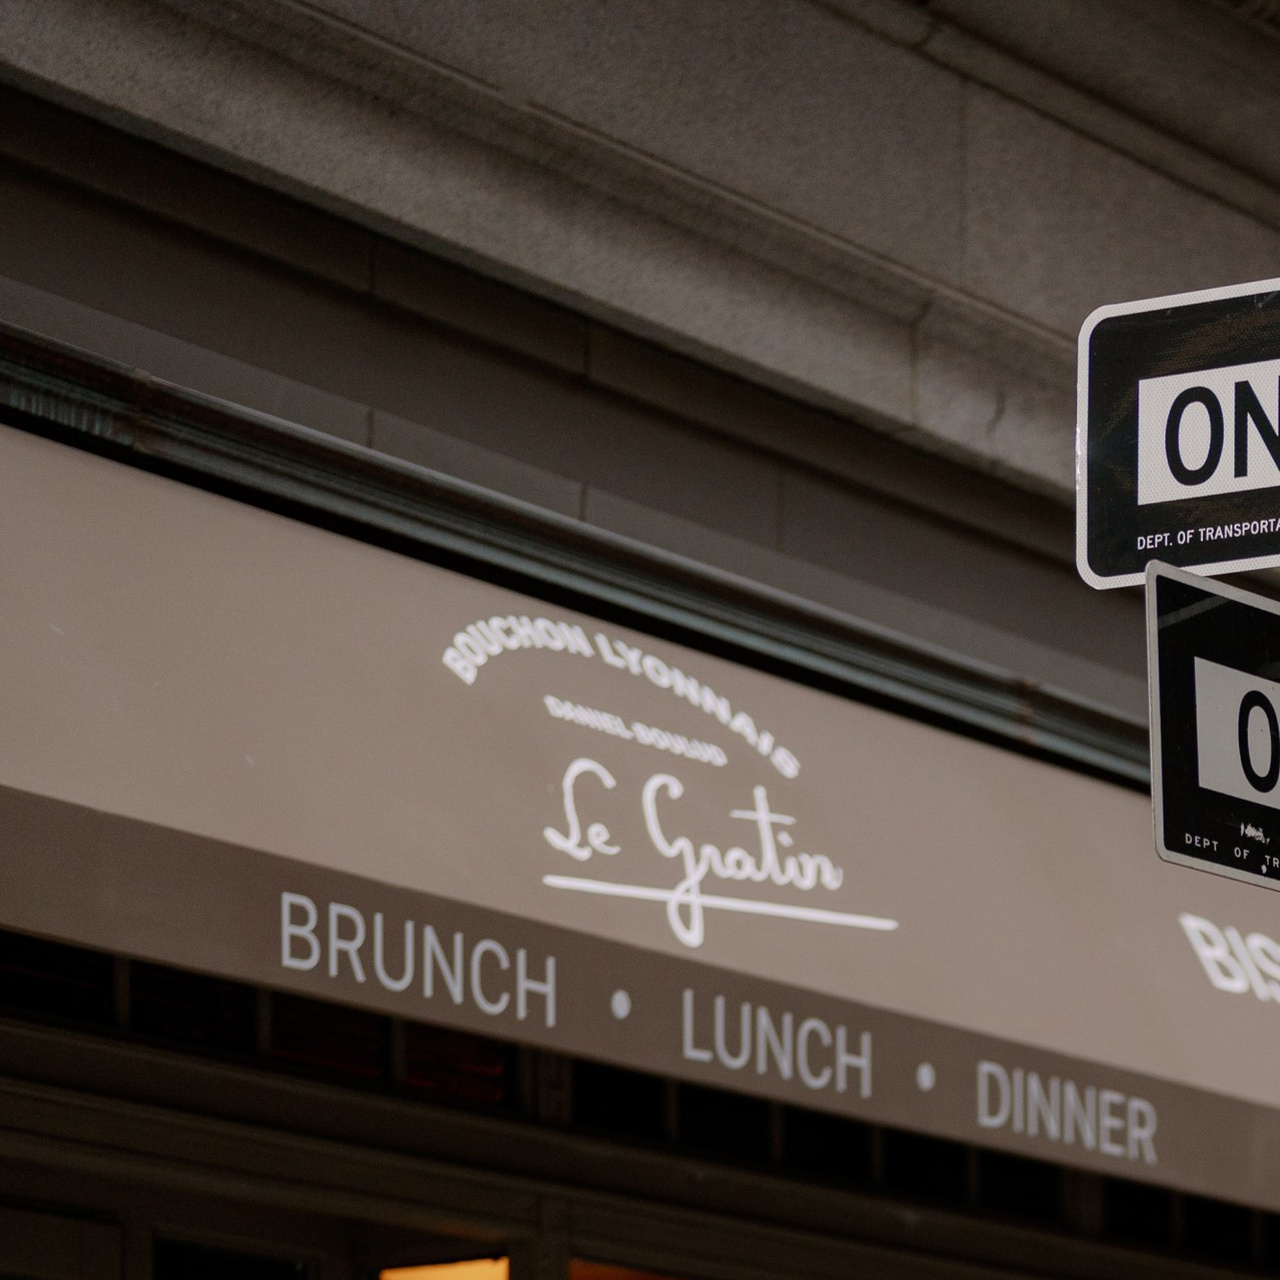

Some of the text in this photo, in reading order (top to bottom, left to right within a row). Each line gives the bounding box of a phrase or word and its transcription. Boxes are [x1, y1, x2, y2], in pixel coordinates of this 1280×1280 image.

[1137, 532, 1173, 550] DEPT.
[1177, 529, 1195, 544] OF
[442, 614, 801, 779] BOUCHON LYONNAIS
[544, 758, 843, 947] Le Gratin
[1184, 832, 1219, 853] DEPT
[1234, 846, 1251, 861] OF
[279, 892, 1159, 1166] BRUNCH LUNCH DINNER
